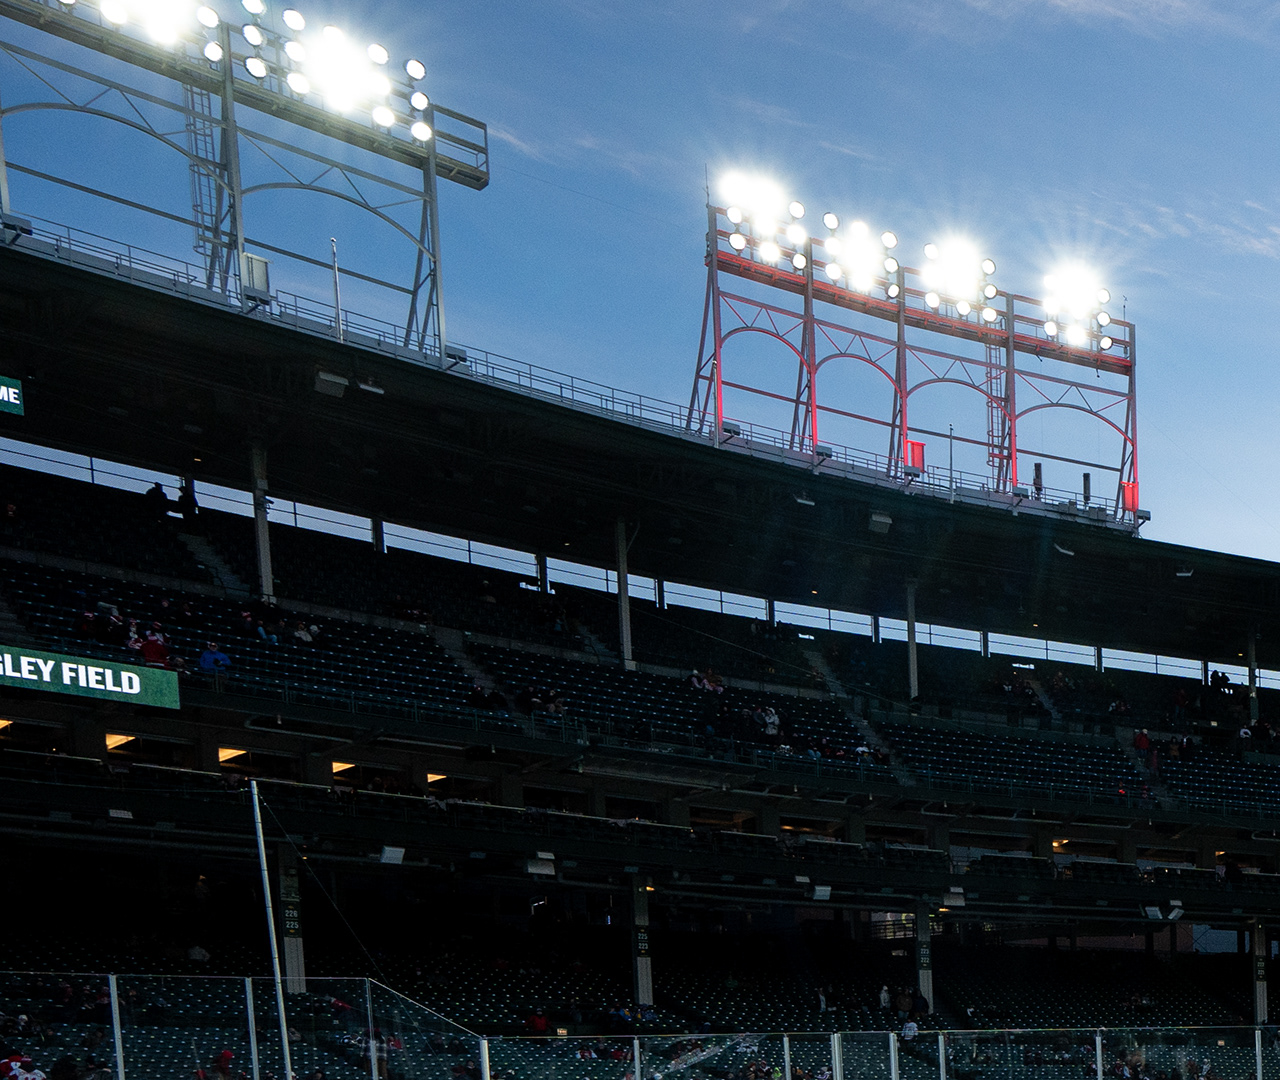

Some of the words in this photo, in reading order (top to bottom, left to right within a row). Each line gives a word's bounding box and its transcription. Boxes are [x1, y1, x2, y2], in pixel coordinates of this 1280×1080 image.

[0, 653, 55, 683] LEY
[61, 662, 141, 695] FIELD
[284, 909, 299, 918] 226
[285, 920, 299, 929] 225
